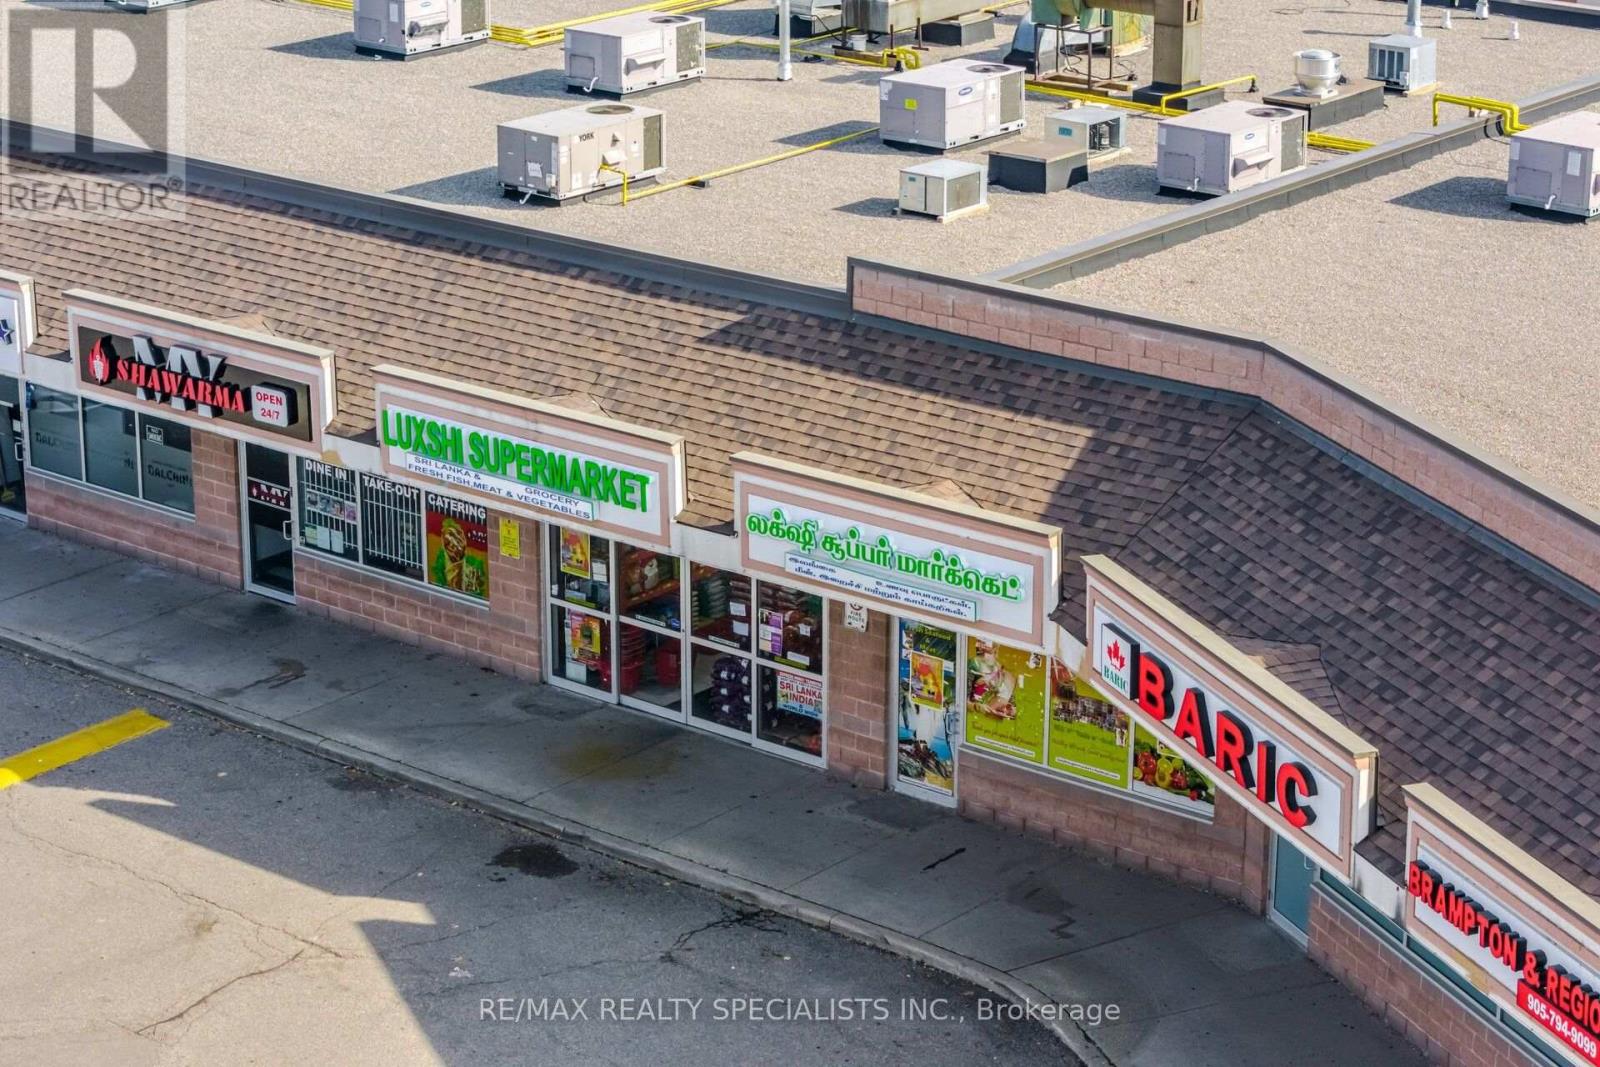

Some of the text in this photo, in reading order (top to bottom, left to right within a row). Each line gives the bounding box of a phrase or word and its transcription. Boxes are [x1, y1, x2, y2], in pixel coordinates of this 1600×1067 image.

[578, 131, 595, 142] YORK
[117, 360, 245, 414] SHAWARMA
[256, 391, 283, 406] OPEN
[261, 407, 281, 420] 24/7
[305, 458, 348, 481] DINE IN
[381, 408, 651, 513] LUXSHI SUPERMARKET
[363, 475, 420, 500] TAKE-OUT
[408, 463, 444, 479] FRESH
[506, 490, 513, 498] &
[516, 493, 591, 519] VEGETABLES
[414, 456, 580, 508] SRI LANKA & GROCERY
[428, 494, 486, 519] CATERING
[821, 527, 892, 569] சூப்பர்
[897, 550, 1022, 601] மார்க்கெட்
[779, 680, 823, 700] SRI LANKA
[1103, 666, 1129, 692] BARIC
[1138, 652, 1317, 828] BARIC
[1409, 861, 1519, 971] BRAMPTON
[1523, 951, 1541, 987] &
[1527, 992, 1597, 1058] 905-794-9099
